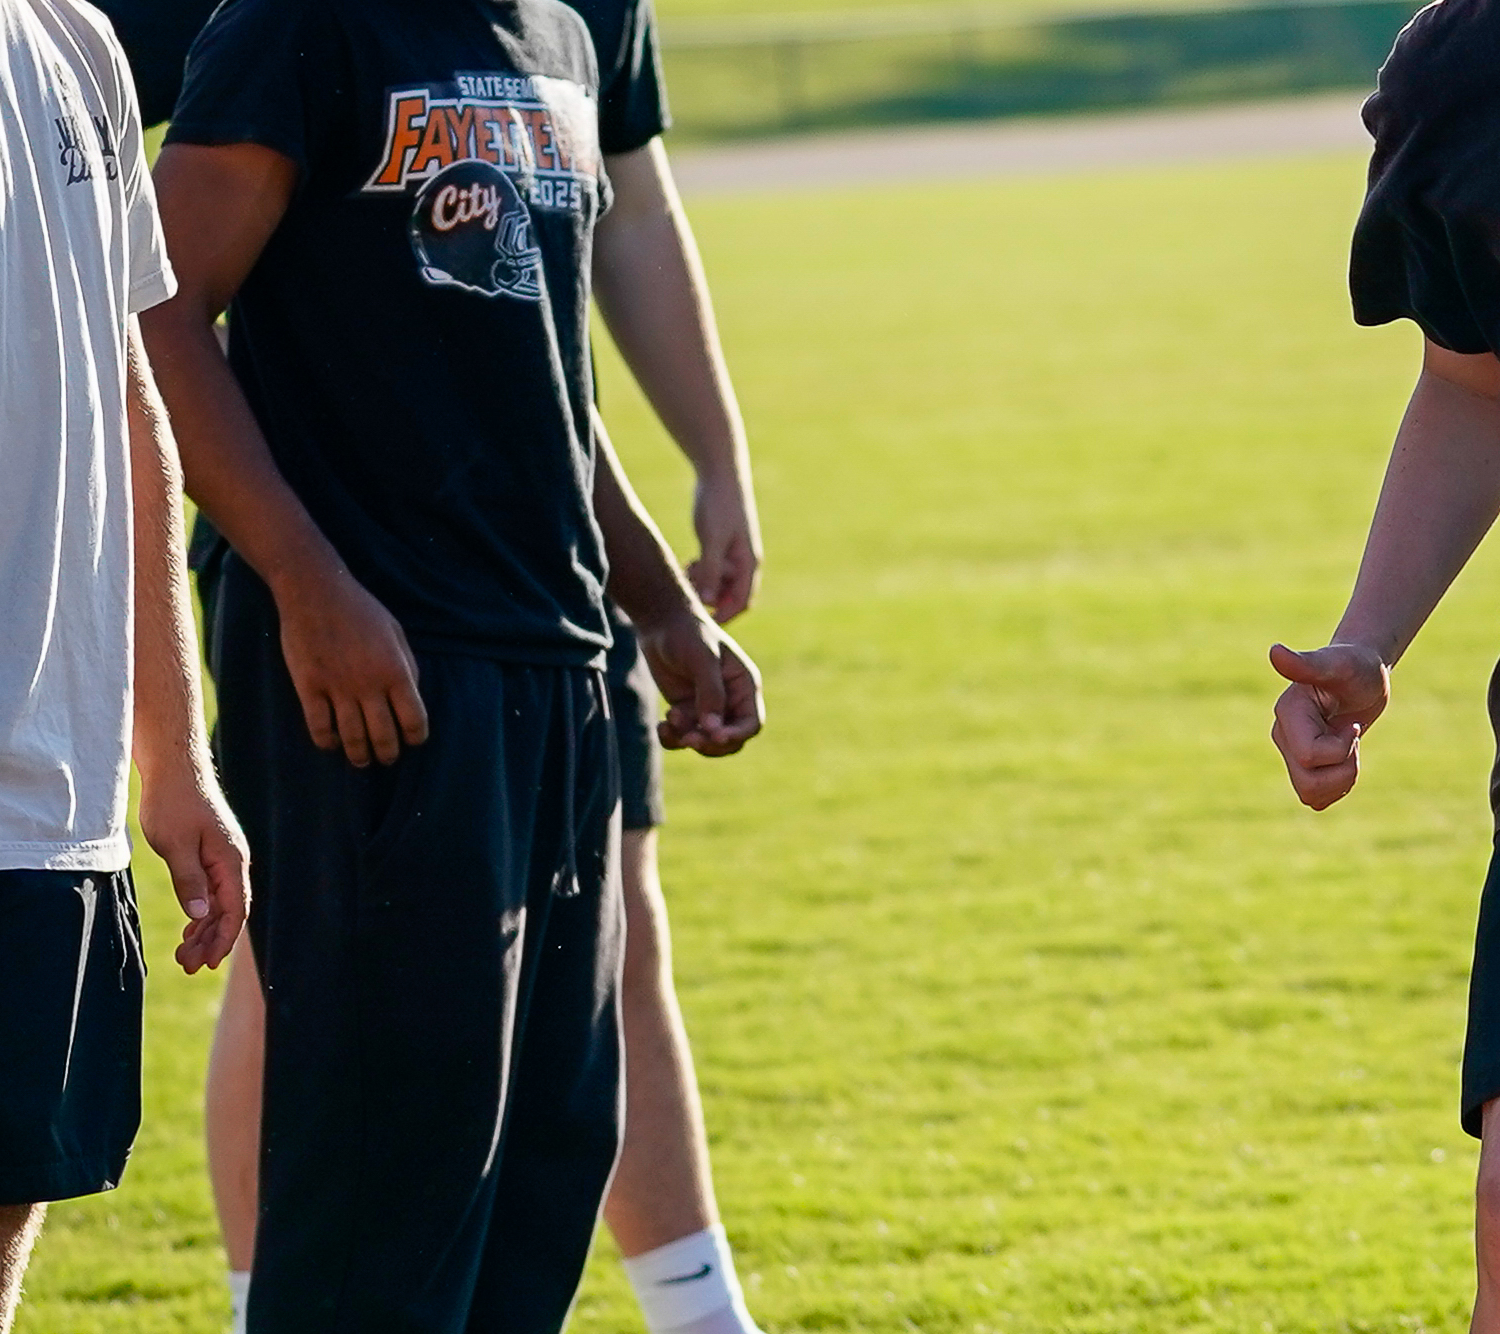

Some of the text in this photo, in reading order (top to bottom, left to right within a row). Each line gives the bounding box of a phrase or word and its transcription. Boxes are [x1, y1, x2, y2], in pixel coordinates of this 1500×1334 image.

[457, 76, 504, 97] STATE
[430, 183, 503, 232] City
[529, 181, 582, 208] 2025
